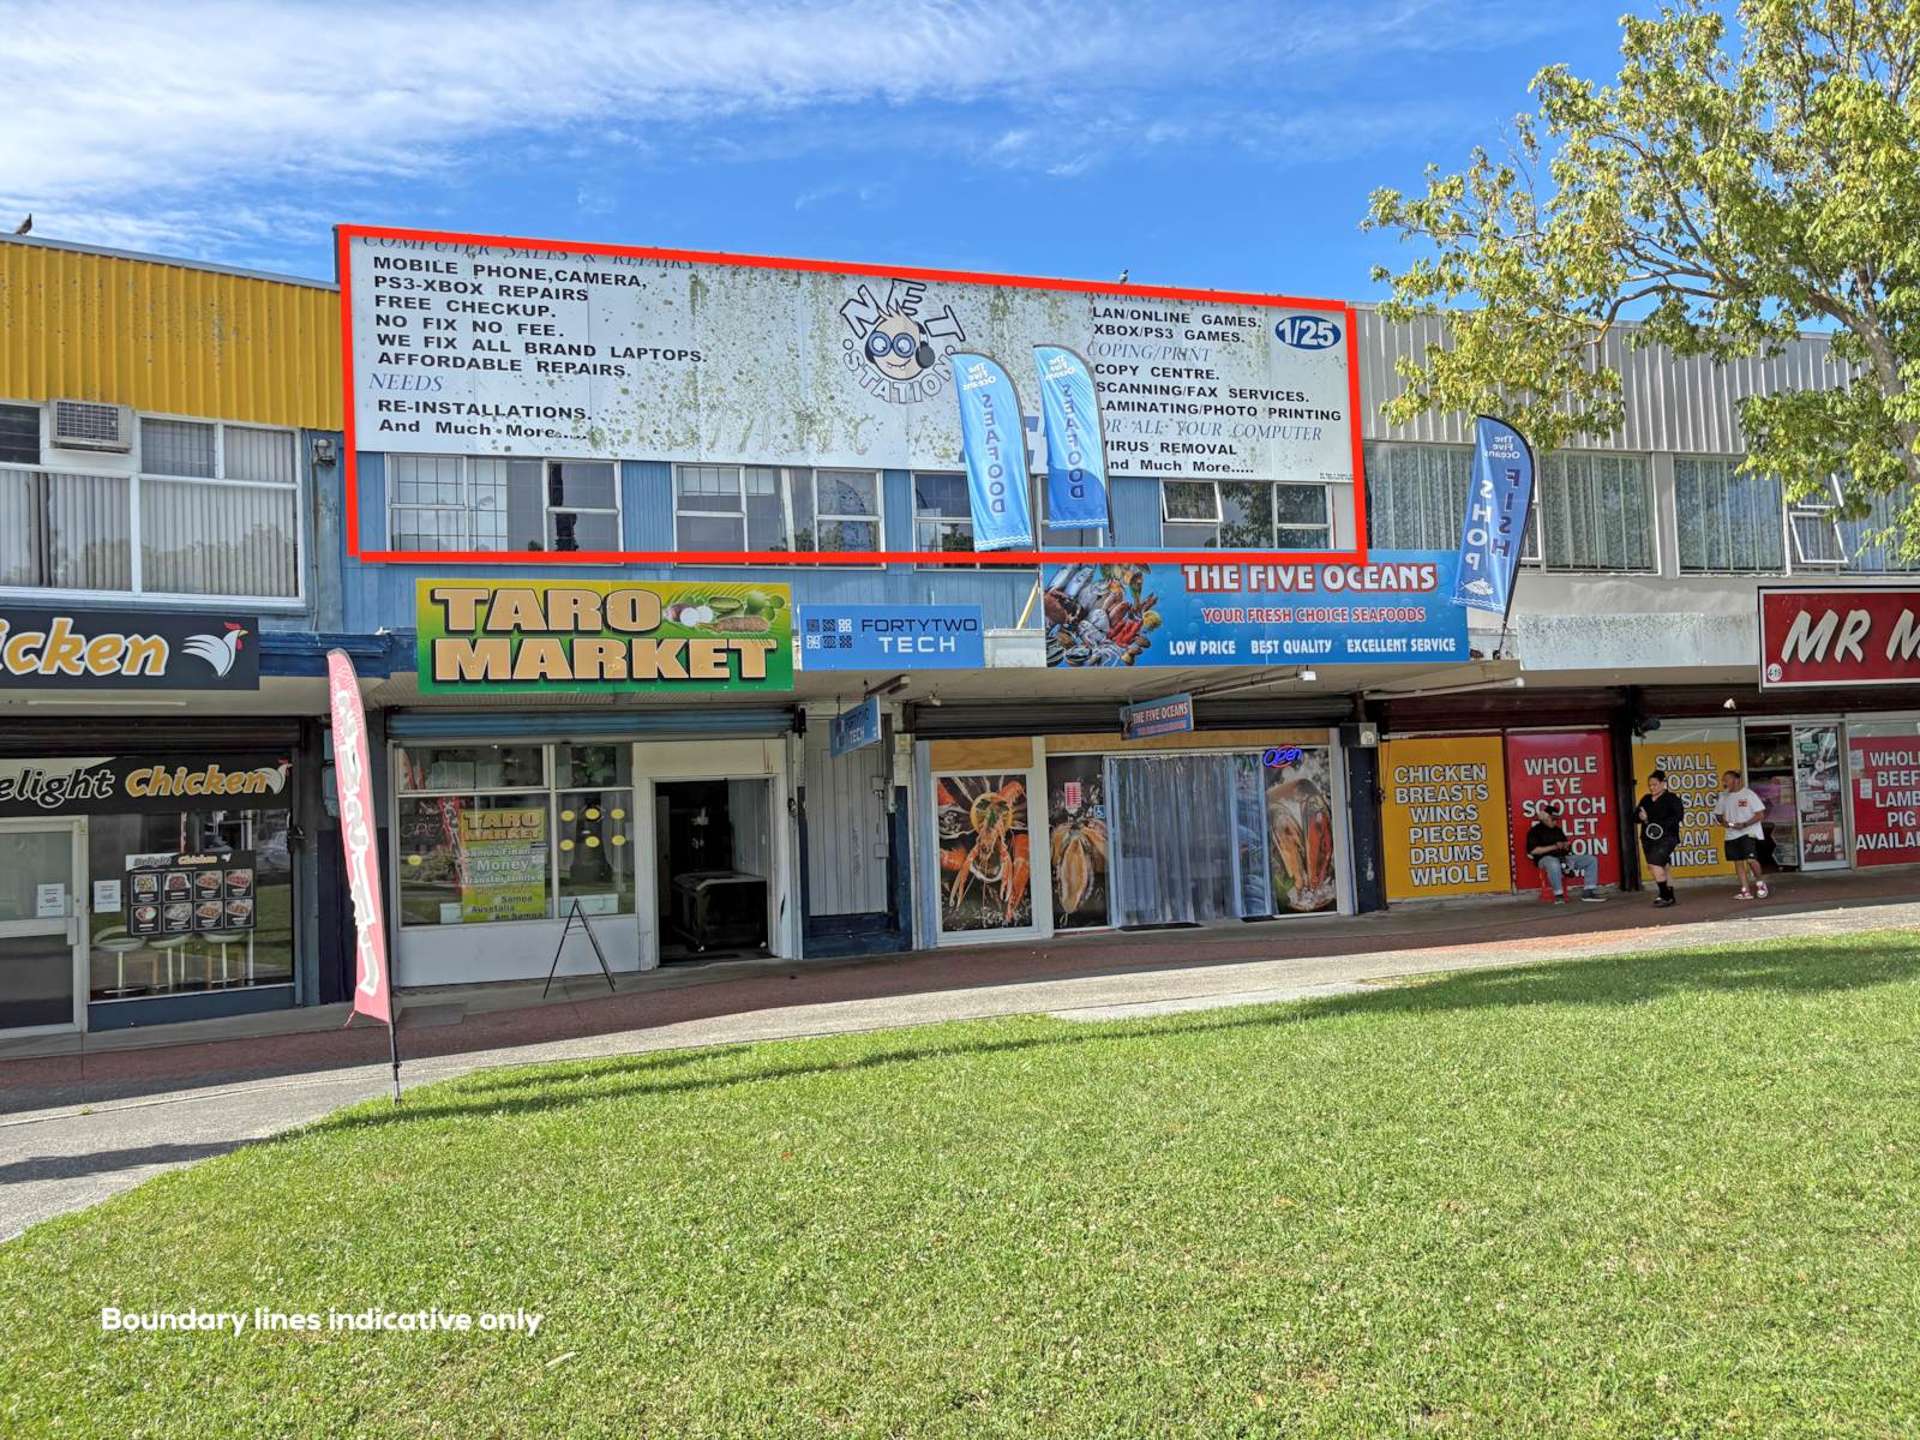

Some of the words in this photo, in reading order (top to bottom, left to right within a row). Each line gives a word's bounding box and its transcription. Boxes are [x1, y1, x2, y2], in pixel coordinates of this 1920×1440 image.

[373, 256, 458, 275] MOBILE
[374, 275, 483, 295] PS3-XBOX
[499, 285, 588, 301] REPAIRS
[375, 295, 431, 310] FREE
[446, 300, 556, 318] CHECKUP.
[840, 278, 966, 341] NET
[376, 314, 407, 328] NO
[424, 318, 457, 331] FIX
[472, 321, 502, 334] NO
[518, 323, 564, 337] FEE.
[1093, 307, 1191, 323] LAN/ONLINE
[1202, 314, 1261, 328] GAMES.
[1094, 324, 1173, 339] XBOX/PS3
[1184, 330, 1245, 343] GAMES.
[1279, 319, 1335, 347] 1/25
[377, 333, 410, 347] WE
[424, 335, 457, 350] FIX
[472, 339, 511, 353] ALL
[525, 342, 596, 358] BRAND
[610, 346, 708, 363] LAPTOPS.
[1087, 340, 1209, 362] COPING/PRINT
[378, 352, 521, 373] AFFORDABLE
[537, 360, 632, 377] REPAIRS.
[1095, 364, 1139, 377] COPY
[1151, 366, 1219, 381] CENTRE.
[369, 373, 443, 392] NEEDS
[843, 349, 953, 405] STATION
[1096, 382, 1218, 398] SCANNING/FAX
[1229, 388, 1310, 403] SERVICES.
[378, 399, 592, 421] RE-INSTALLATIONS.
[1101, 401, 1257, 416] AMINATING/PHOTO
[1269, 407, 1342, 421] PRINTING
[379, 420, 420, 433] And
[435, 421, 492, 436] Much
[1133, 420, 1161, 434] ALL
[1176, 421, 1222, 436] YOUR
[1233, 424, 1322, 441] COMPUTER
[1105, 440, 1149, 453] IRUS
[1160, 442, 1237, 456] REMOVAL
[1107, 459, 1129, 470] nd
[1140, 459, 1182, 471] Much
[1183, 563, 1241, 593] THE
[1248, 563, 1315, 593] FIVE
[1322, 563, 1439, 593] OCEANS
[431, 588, 662, 633] TARO
[1201, 608, 1244, 624] YOUR
[1247, 607, 1292, 623] FRESH
[1296, 607, 1348, 623] CHOICE
[1352, 606, 1426, 622] SEAFOODS
[861, 618, 978, 633] FORTYTWO
[878, 636, 956, 653] TECH
[1781, 608, 1872, 664] MR
[1169, 640, 1196, 656] LOW
[1200, 640, 1236, 655] PRICE
[1251, 640, 1279, 655] BEST
[1283, 639, 1332, 655] QUALITY
[1347, 638, 1407, 654] EXCELLENT
[1411, 638, 1456, 653] SERVICE
[431, 638, 777, 684] MARKET
[1132, 711, 1144, 724] THE
[1146, 708, 1159, 721] FIVE
[1161, 702, 1188, 719] OCEANS
[1524, 756, 1598, 776] WHOLE
[1655, 754, 1716, 771] SMALL
[125, 764, 267, 798] Chicken
[1394, 763, 1487, 784] CHICKEN
[1664, 773, 1718, 790] OODS
[1877, 770, 1920, 787] BEEF
[1395, 784, 1489, 804] BREASTS
[1542, 777, 1582, 796] EYE
[1410, 804, 1479, 824] WINGS
[1887, 810, 1917, 828] PIG
[1409, 824, 1482, 844] PIECES
[1679, 830, 1710, 847] AM
[476, 858, 530, 872] Money
[1410, 845, 1483, 865] DRUMS
[1410, 864, 1489, 887] WHOLE
